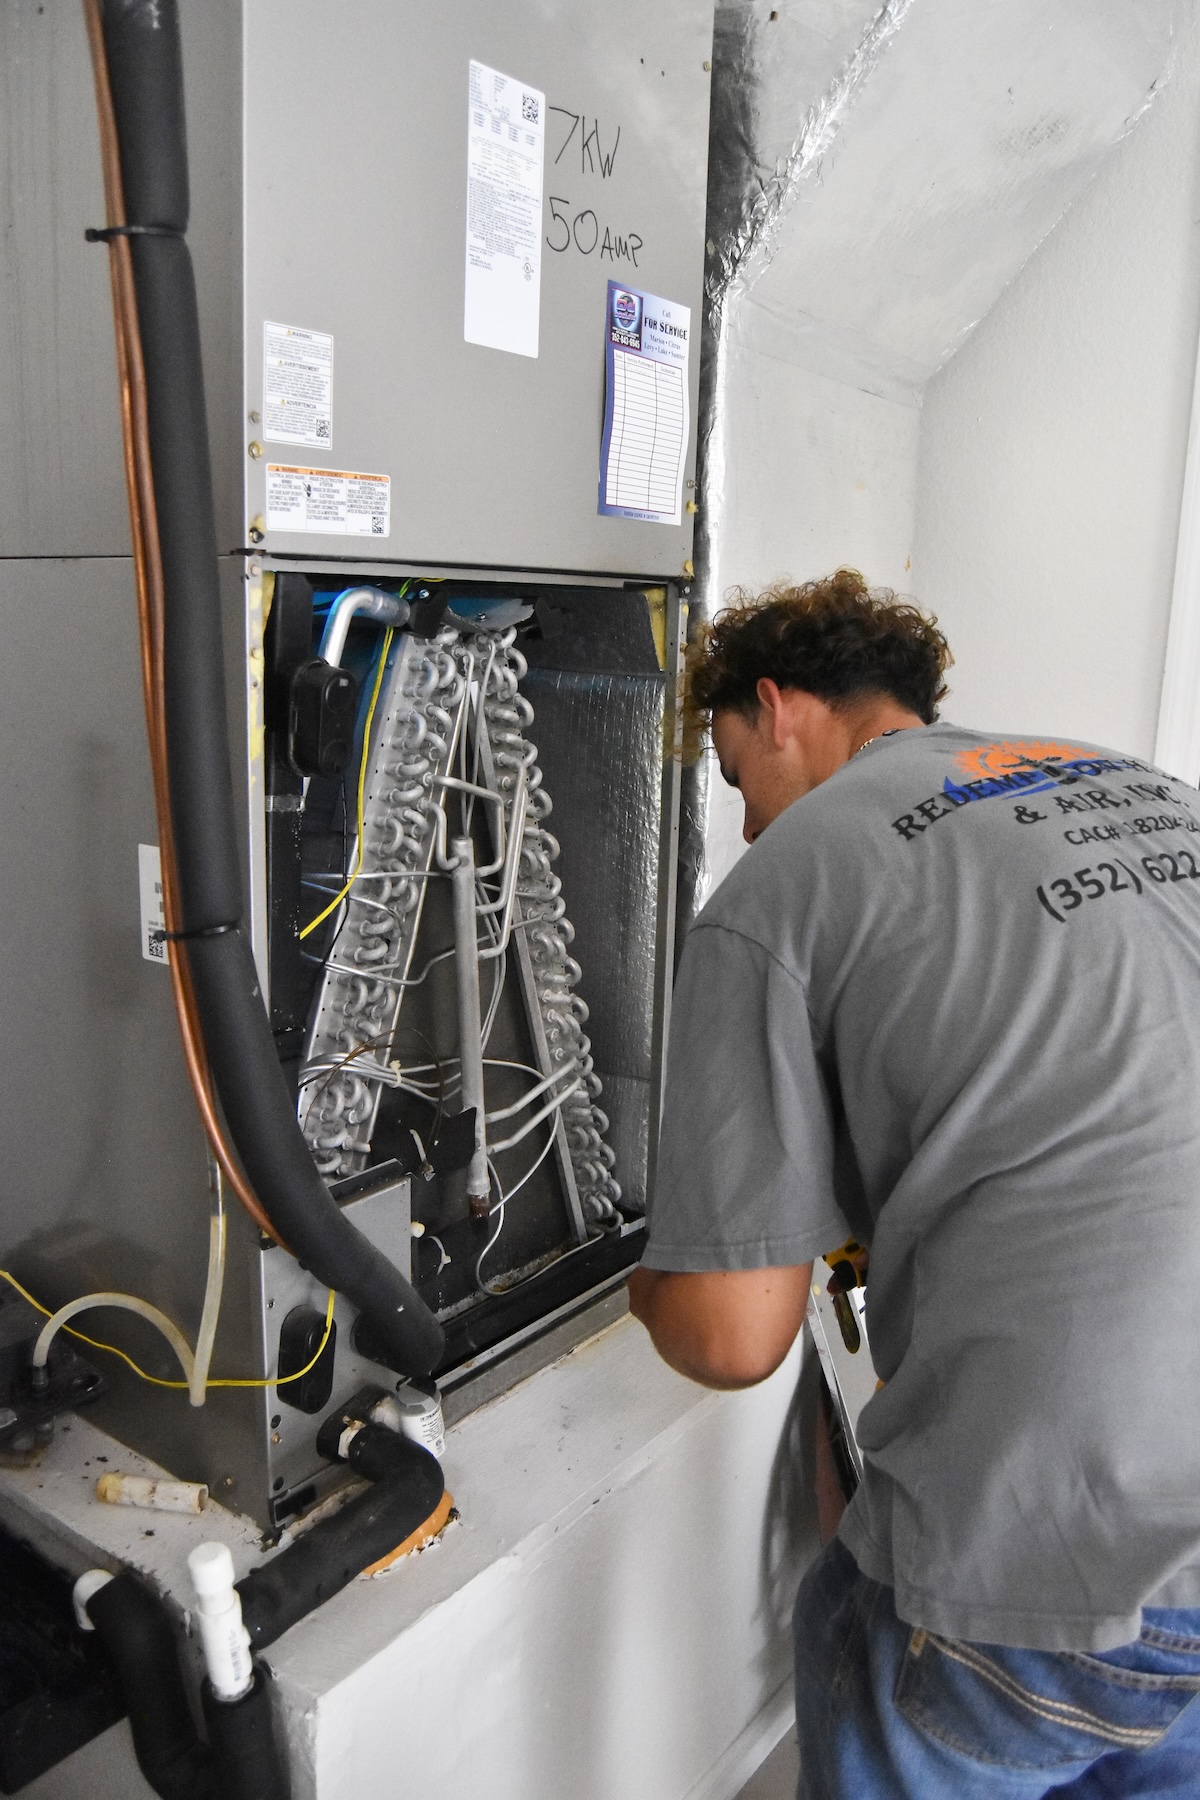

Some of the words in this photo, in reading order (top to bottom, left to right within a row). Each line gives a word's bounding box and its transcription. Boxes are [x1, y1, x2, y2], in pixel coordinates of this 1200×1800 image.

[662, 310, 671, 319] Call
[292, 330, 313, 340] WARNING
[644, 316, 658, 331] FOR
[659, 321, 688, 341] SERVICE
[644, 341, 655, 352] Levy
[650, 334, 666, 345] Marion
[668, 340, 681, 350] Citrus
[1014, 805, 1047, 824] &
[1053, 790, 1131, 814] AIR,
[1064, 825, 1121, 845] CAC#
[1036, 858, 1143, 922] (352)
